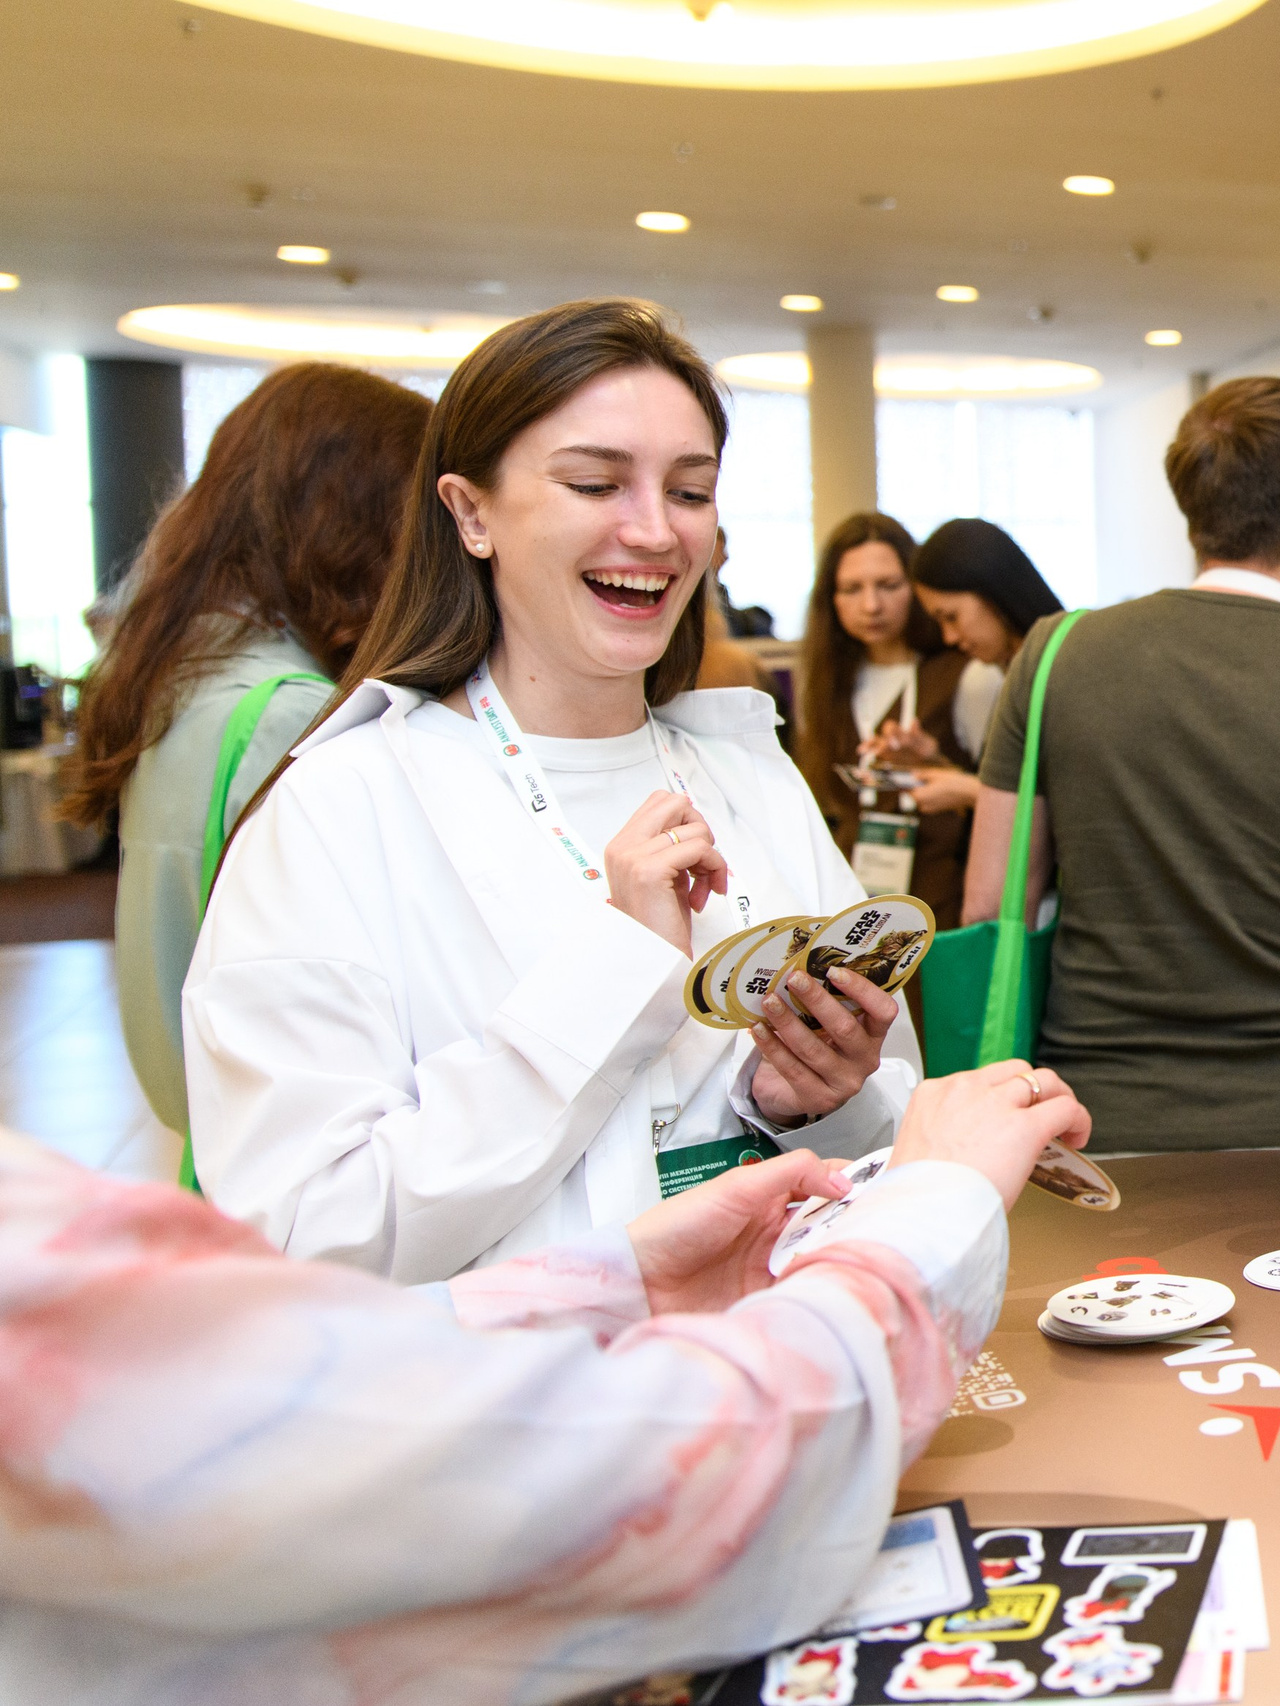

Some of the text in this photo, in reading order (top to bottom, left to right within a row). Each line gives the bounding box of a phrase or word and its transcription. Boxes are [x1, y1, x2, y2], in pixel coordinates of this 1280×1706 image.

[489, 719, 511, 743] ANALYST
[524, 773, 540, 793] Tech
[567, 847, 589, 868] ANALYST
[846, 909, 878, 945] STAR
[849, 911, 883, 948] WARS
[745, 985, 769, 995] AR
[748, 977, 771, 986] RS
[670, 1160, 728, 1179] МЕЖДУНАРОДНАЯ
[660, 1173, 703, 1188] ОНФЕРЕНЦИЯ
